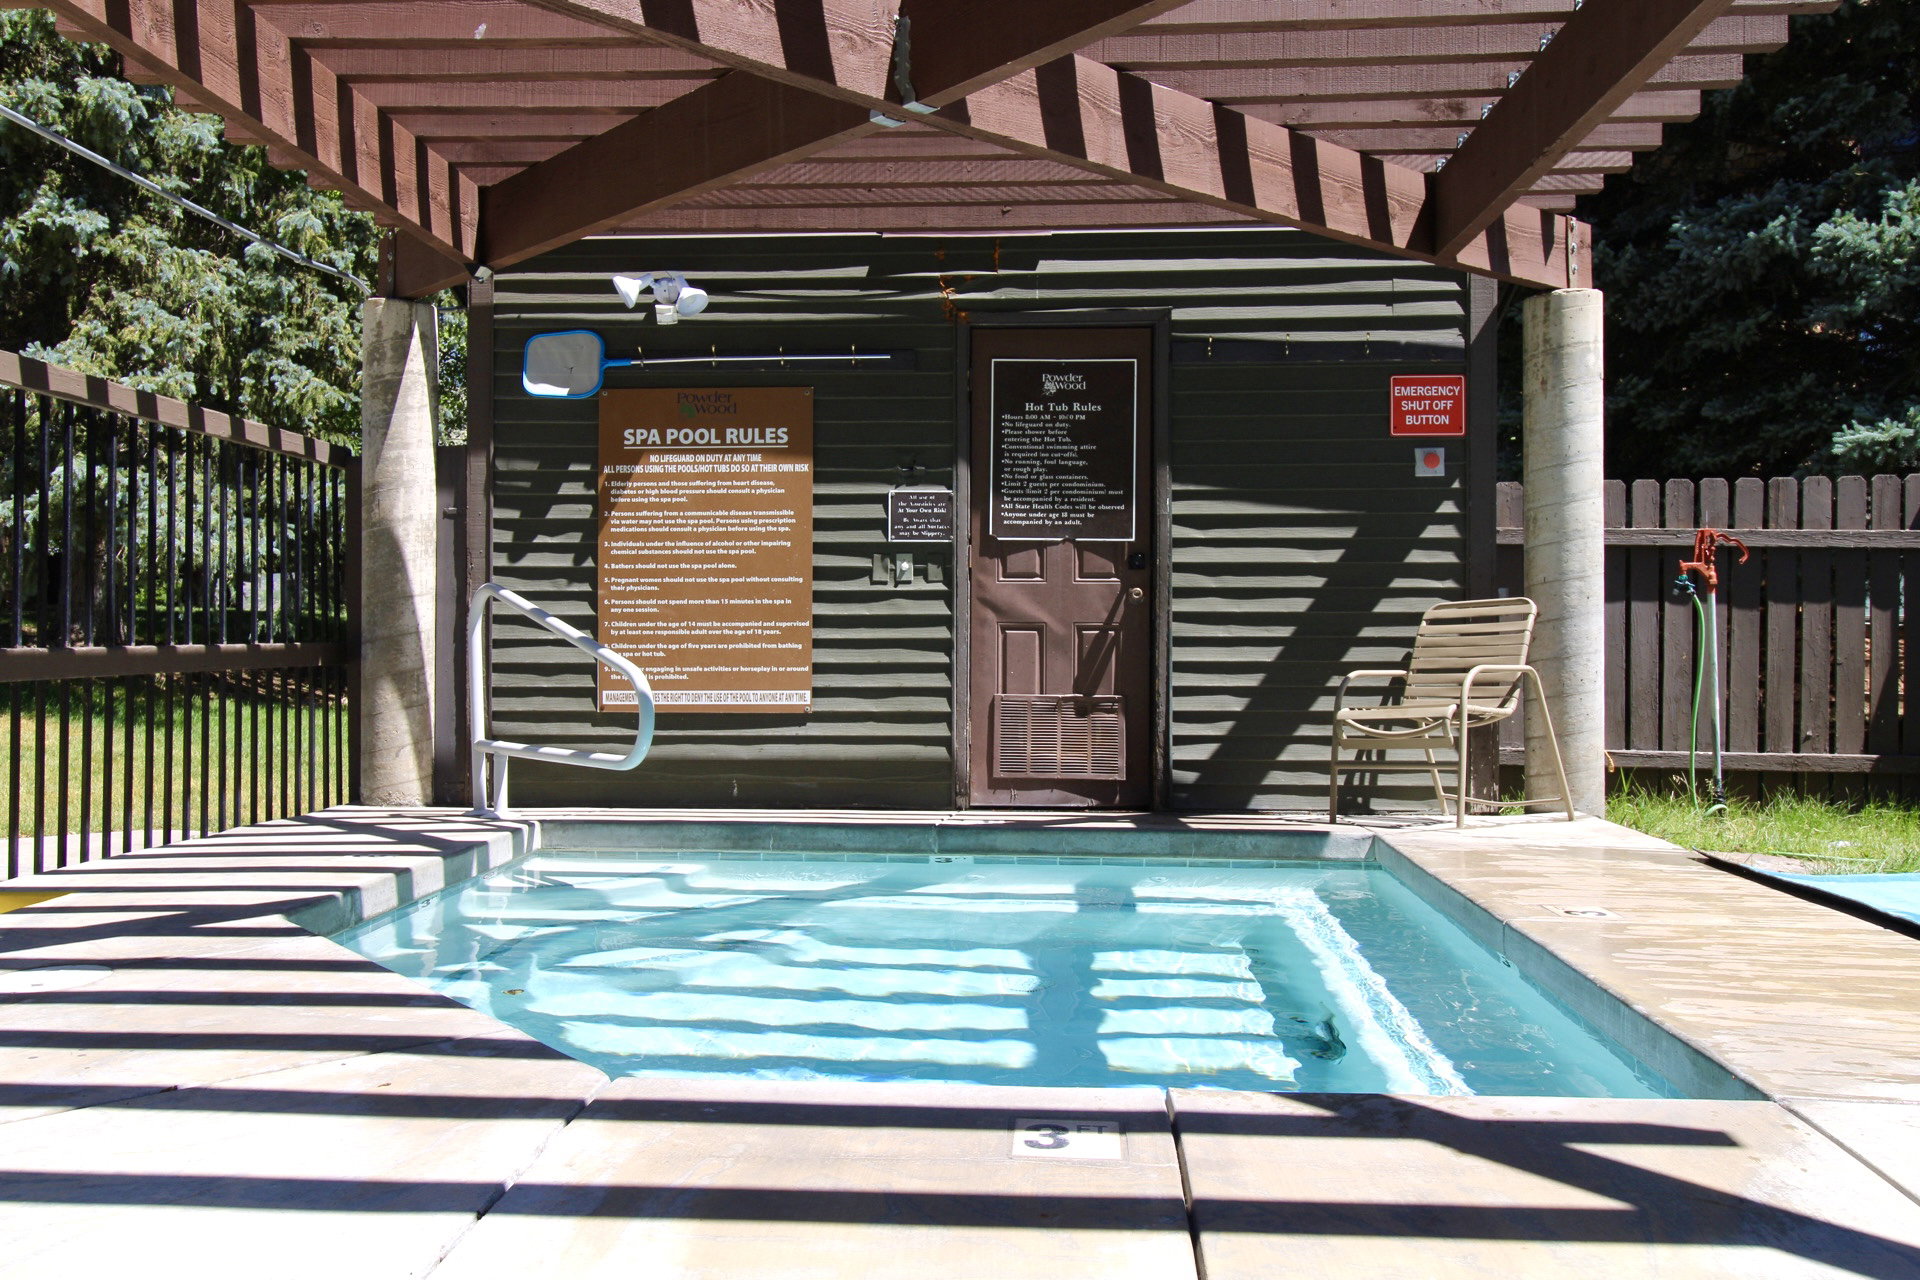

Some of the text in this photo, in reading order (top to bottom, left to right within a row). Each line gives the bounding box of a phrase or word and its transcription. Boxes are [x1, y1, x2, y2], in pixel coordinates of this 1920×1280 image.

[1042, 373, 1083, 382] Powder
[1054, 382, 1086, 390] Wood
[1394, 386, 1460, 396] EMERGENCY
[678, 390, 733, 404] Powder
[694, 402, 737, 414] Wood
[1025, 403, 1101, 411] Hot Tub Rules
[1402, 400, 1454, 410] SHUT OFF
[1406, 415, 1449, 424] BUTTON
[624, 427, 788, 445] SPA POOL RULES
[650, 452, 761, 463] NO LIFEGUARD ON DUTY AT ANY TIME
[604, 464, 809, 474] ALL PERSONS USING THE POOLS/HOT TUBS DO SO AT THEIR OWN RISK
[611, 480, 632, 488] Elderly
[689, 480, 716, 488] suffering
[645, 488, 659, 496] high
[756, 487, 784, 495] physician
[1024, 1124, 1107, 1150] 3 FT
